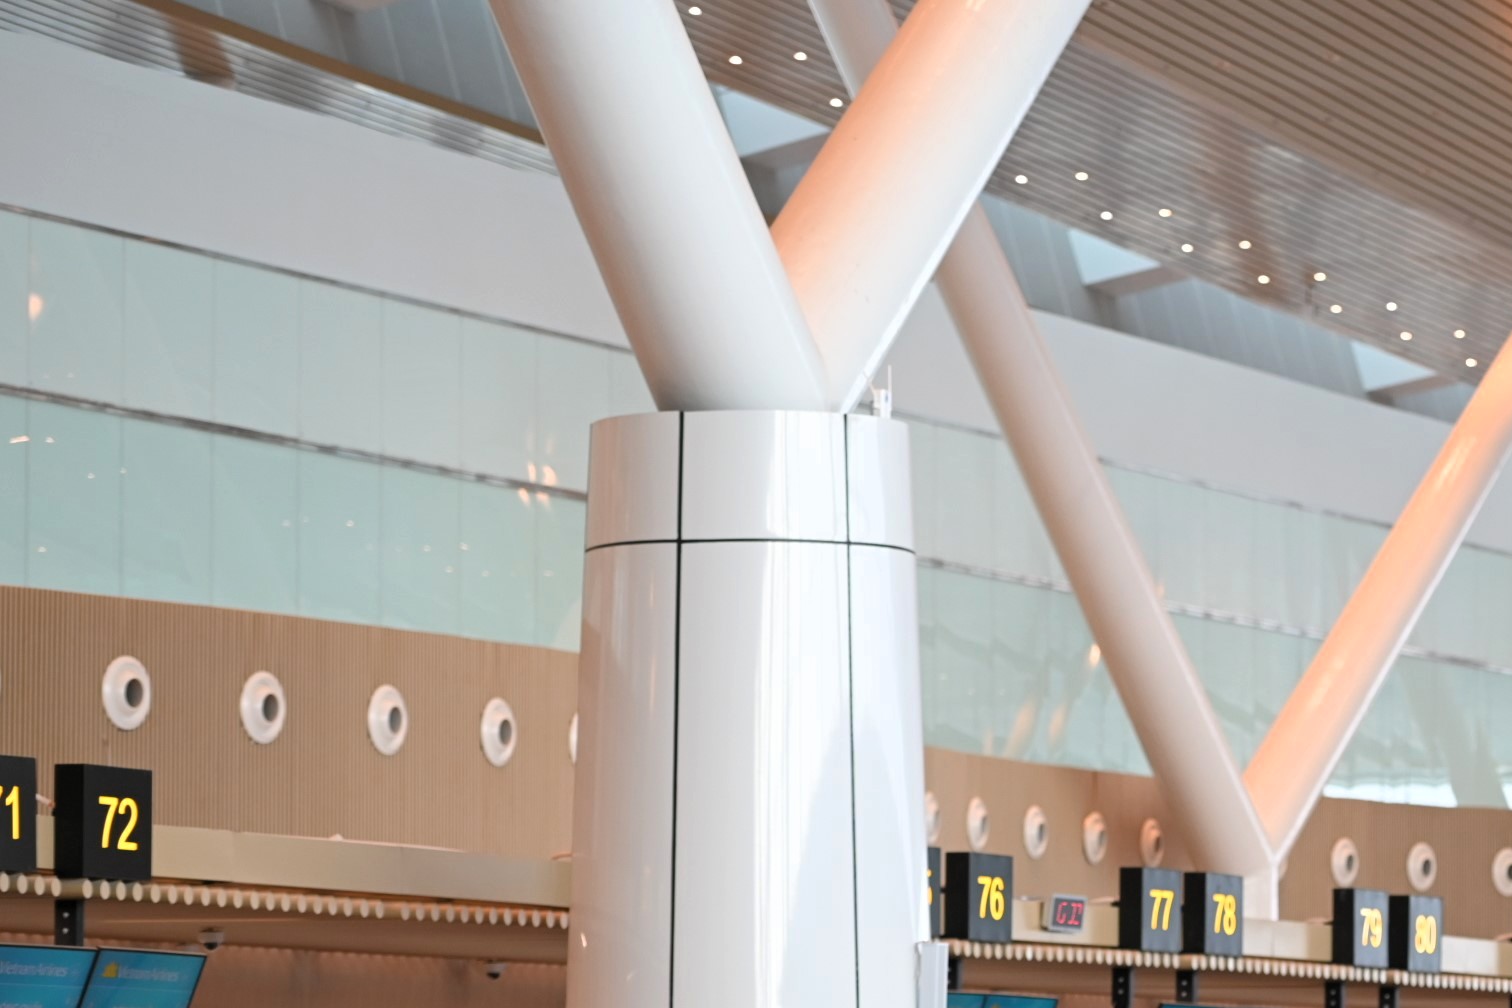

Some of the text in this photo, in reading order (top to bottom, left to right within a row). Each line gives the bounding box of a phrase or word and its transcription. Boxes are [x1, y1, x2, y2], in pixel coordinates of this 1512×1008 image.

[0, 786, 20, 839] 1
[99, 796, 139, 851] 72
[977, 876, 1004, 921] 76
[1150, 888, 1173, 930] 77
[1213, 893, 1236, 935] 78
[1360, 908, 1382, 947] 79
[1414, 915, 1436, 954] 80
